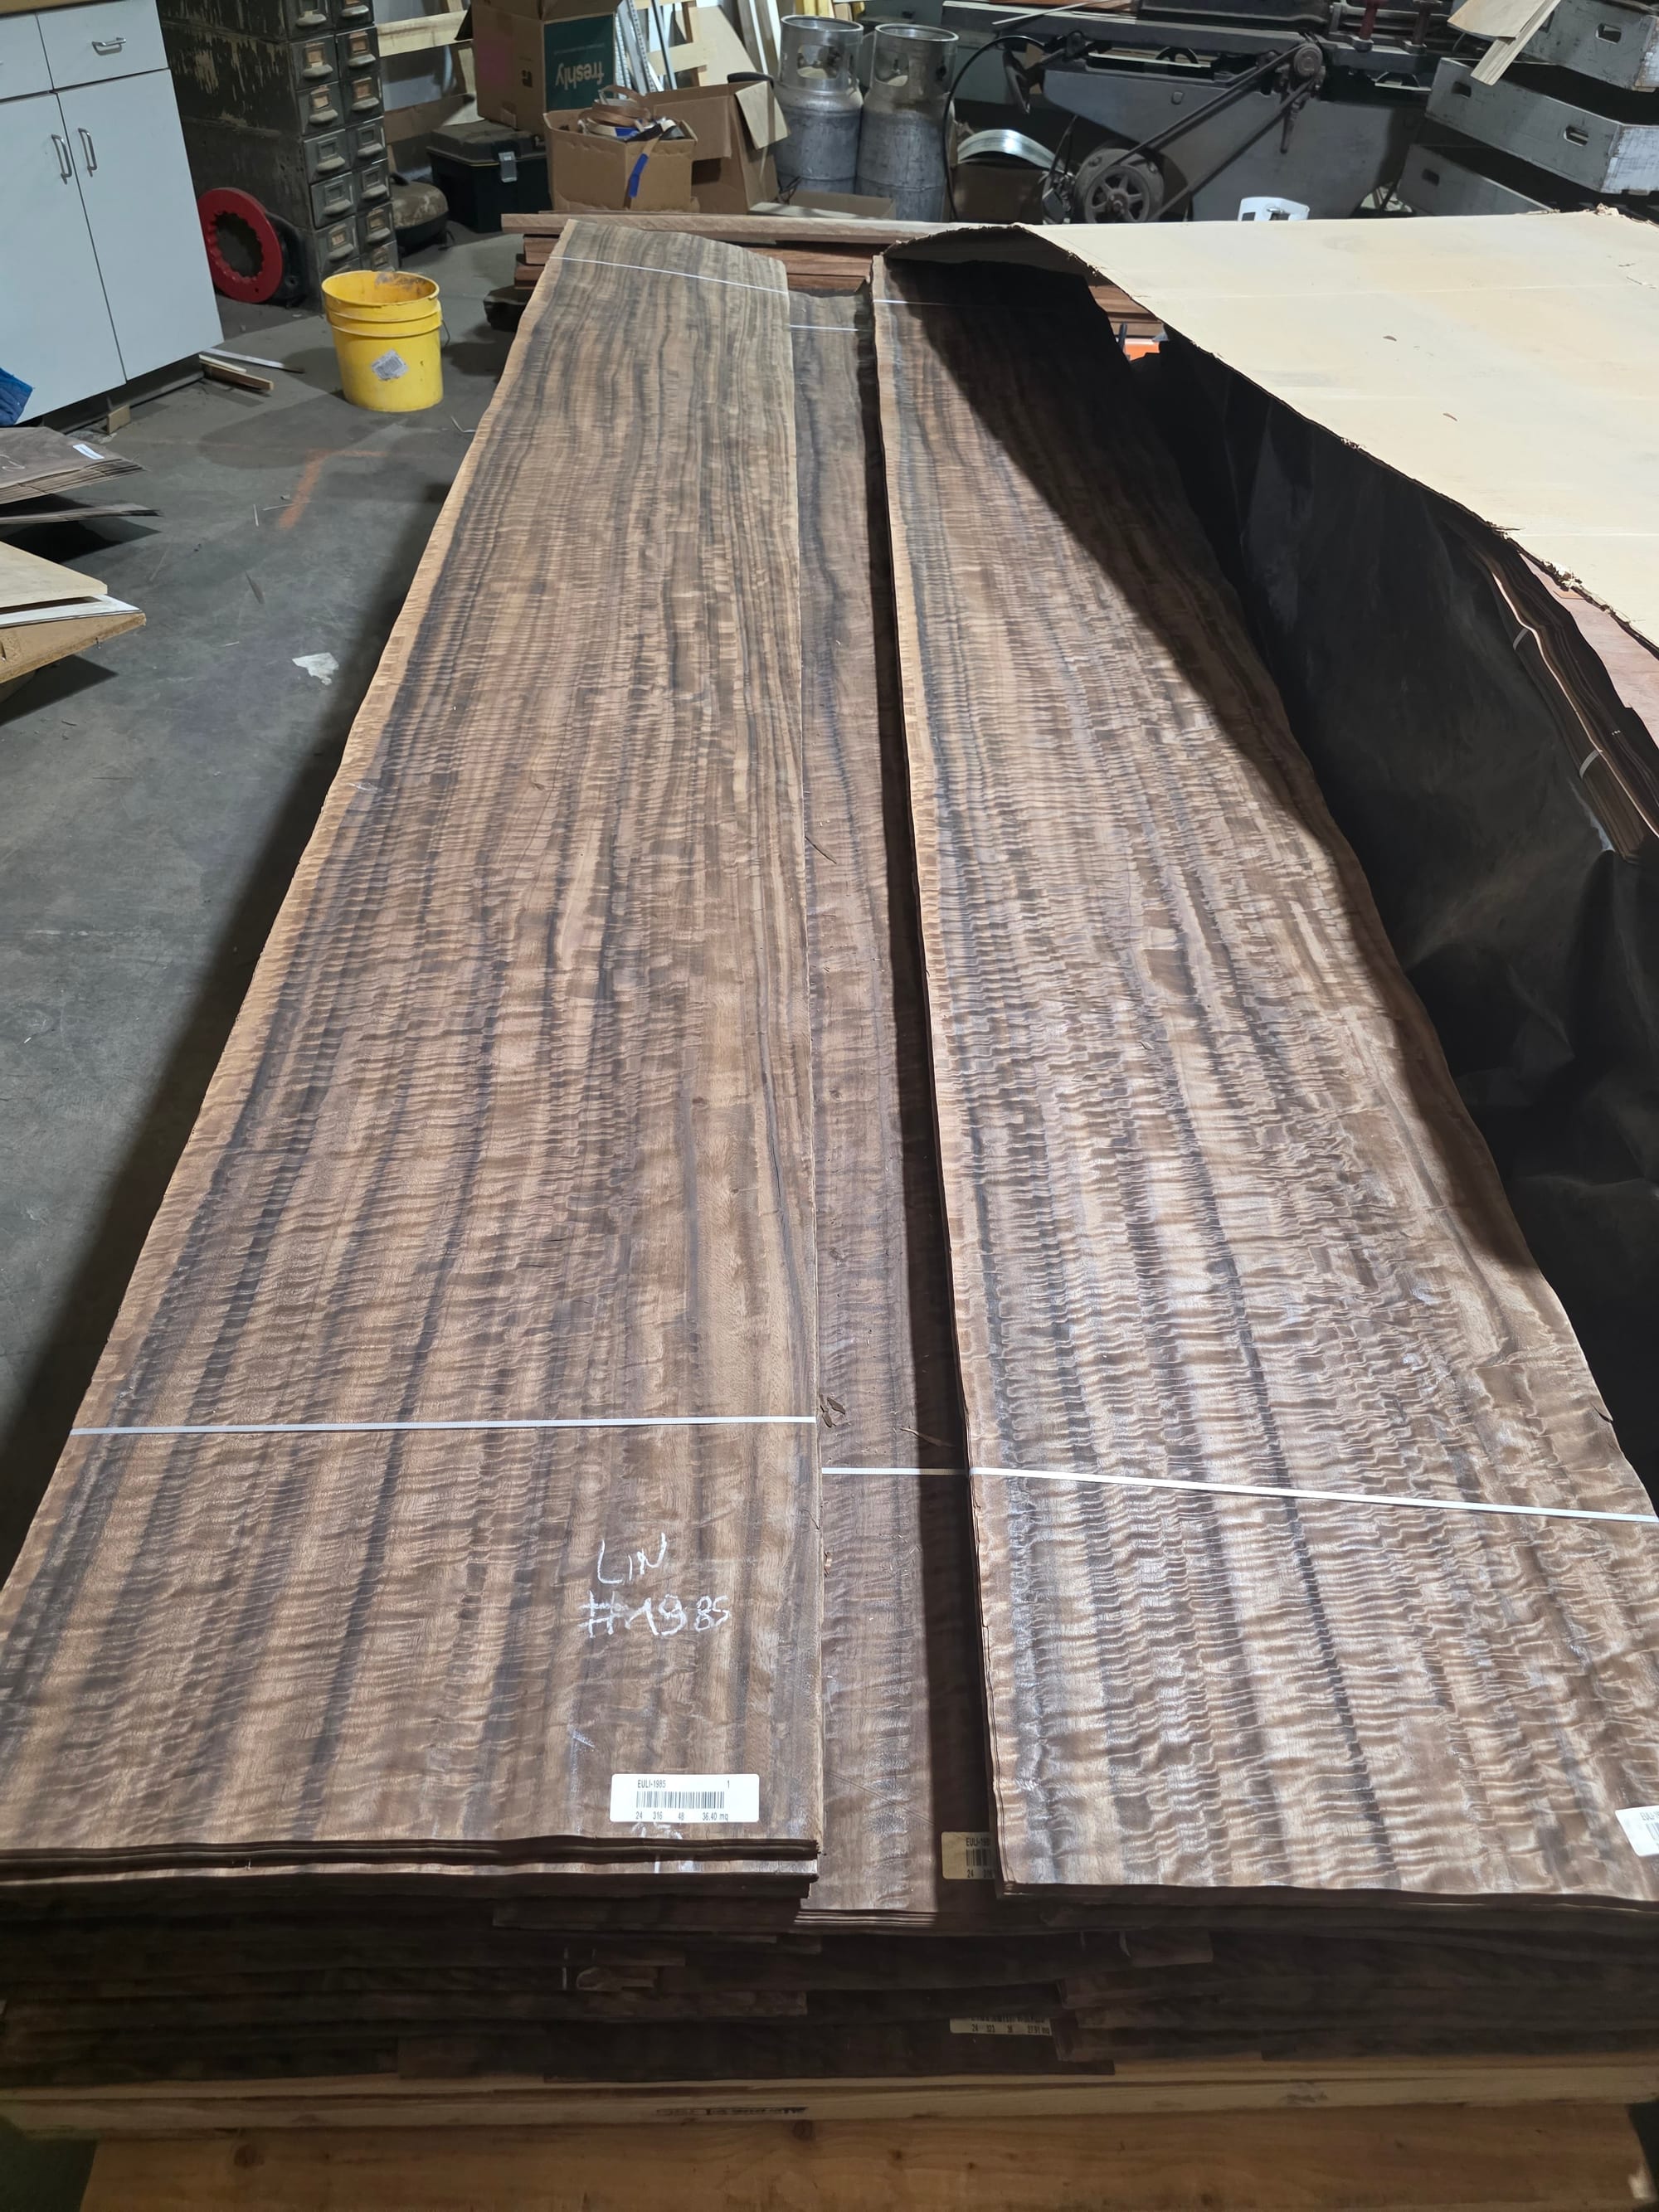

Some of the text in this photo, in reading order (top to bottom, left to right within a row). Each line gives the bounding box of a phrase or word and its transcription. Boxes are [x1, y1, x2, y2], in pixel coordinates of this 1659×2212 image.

[555, 61, 605, 90] freshly
[637, 1779, 667, 1789] EULI-1985
[635, 1811, 729, 1822] 24 316 48 36.40 mq
